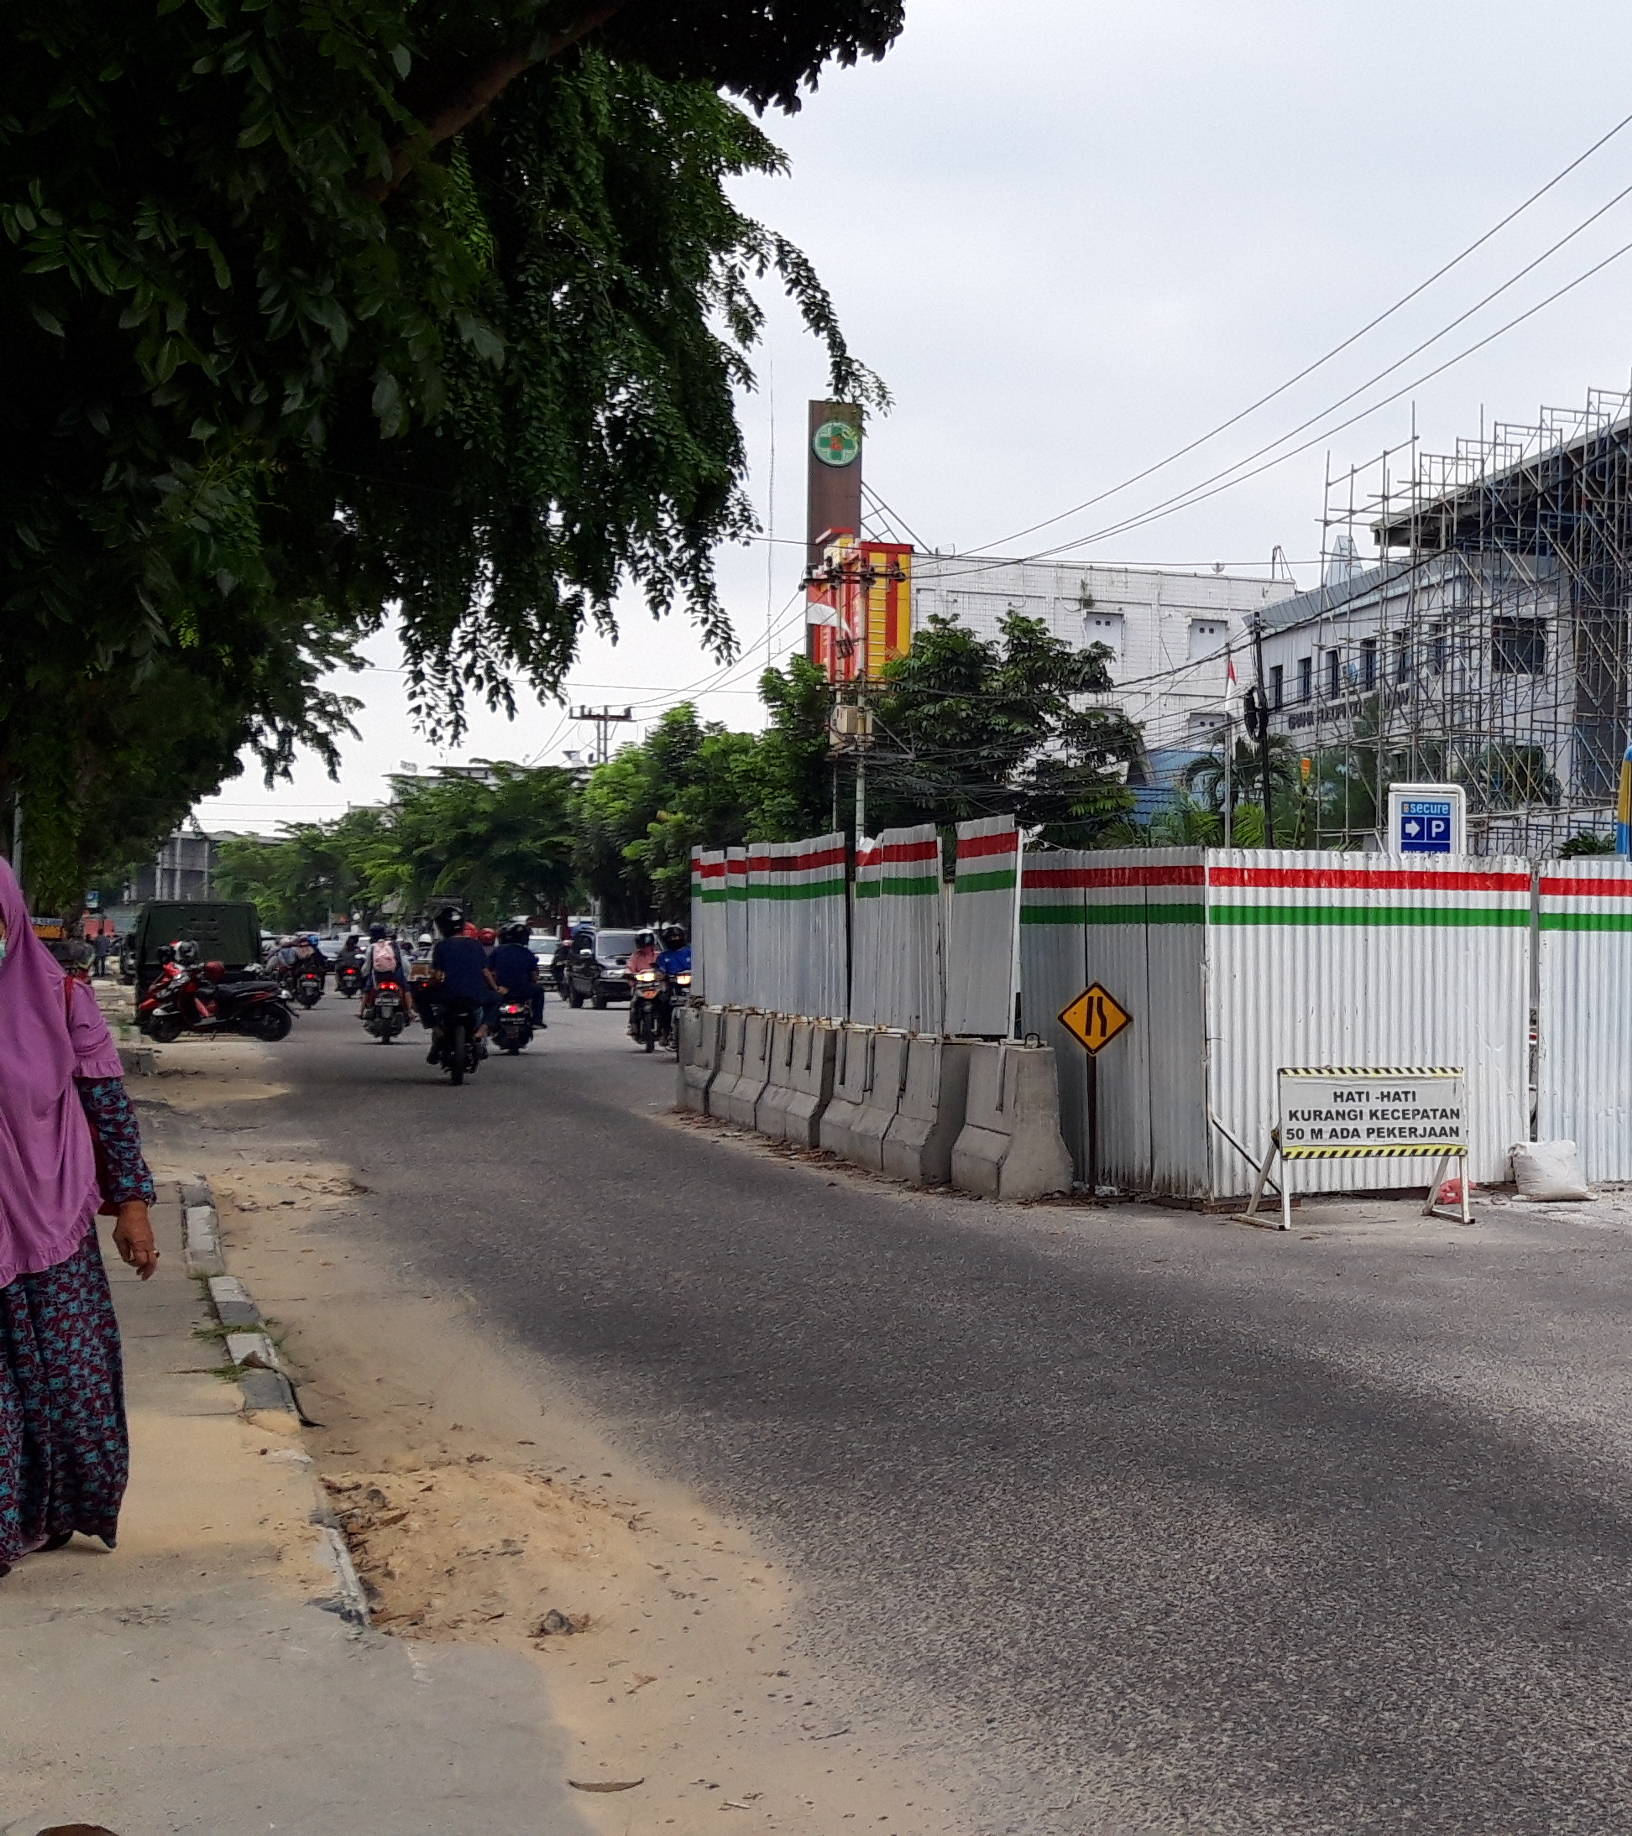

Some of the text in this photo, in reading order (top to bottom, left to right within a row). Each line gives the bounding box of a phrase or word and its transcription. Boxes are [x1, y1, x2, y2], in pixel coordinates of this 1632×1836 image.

[1410, 803, 1449, 815] secure
[1431, 820, 1445, 838] P
[1333, 1091, 1369, 1103] HATI
[1288, 1107, 1460, 1122] KURANGI KECEPATAN
[1286, 1126, 1459, 1140] 50 M ADA PEKERJAAN
